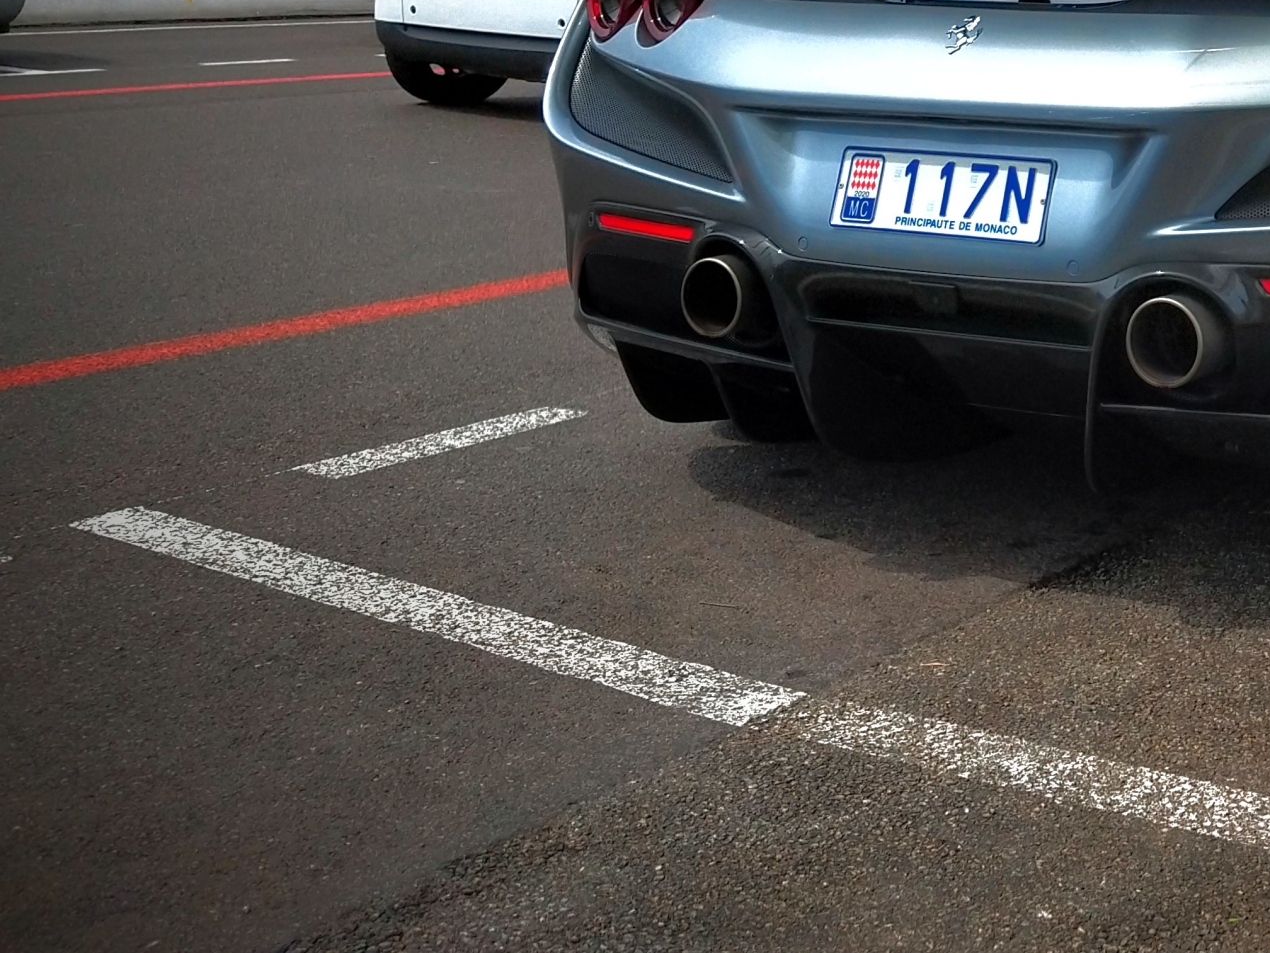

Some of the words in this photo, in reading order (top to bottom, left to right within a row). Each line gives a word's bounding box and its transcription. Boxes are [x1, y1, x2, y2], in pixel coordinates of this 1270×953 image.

[854, 190, 870, 198] 2020
[904, 159, 1037, 224] 117N
[848, 200, 869, 217] MC
[894, 216, 955, 230] PRINCIPAUTE
[958, 221, 972, 231] DE
[975, 222, 1018, 235] MONACO
